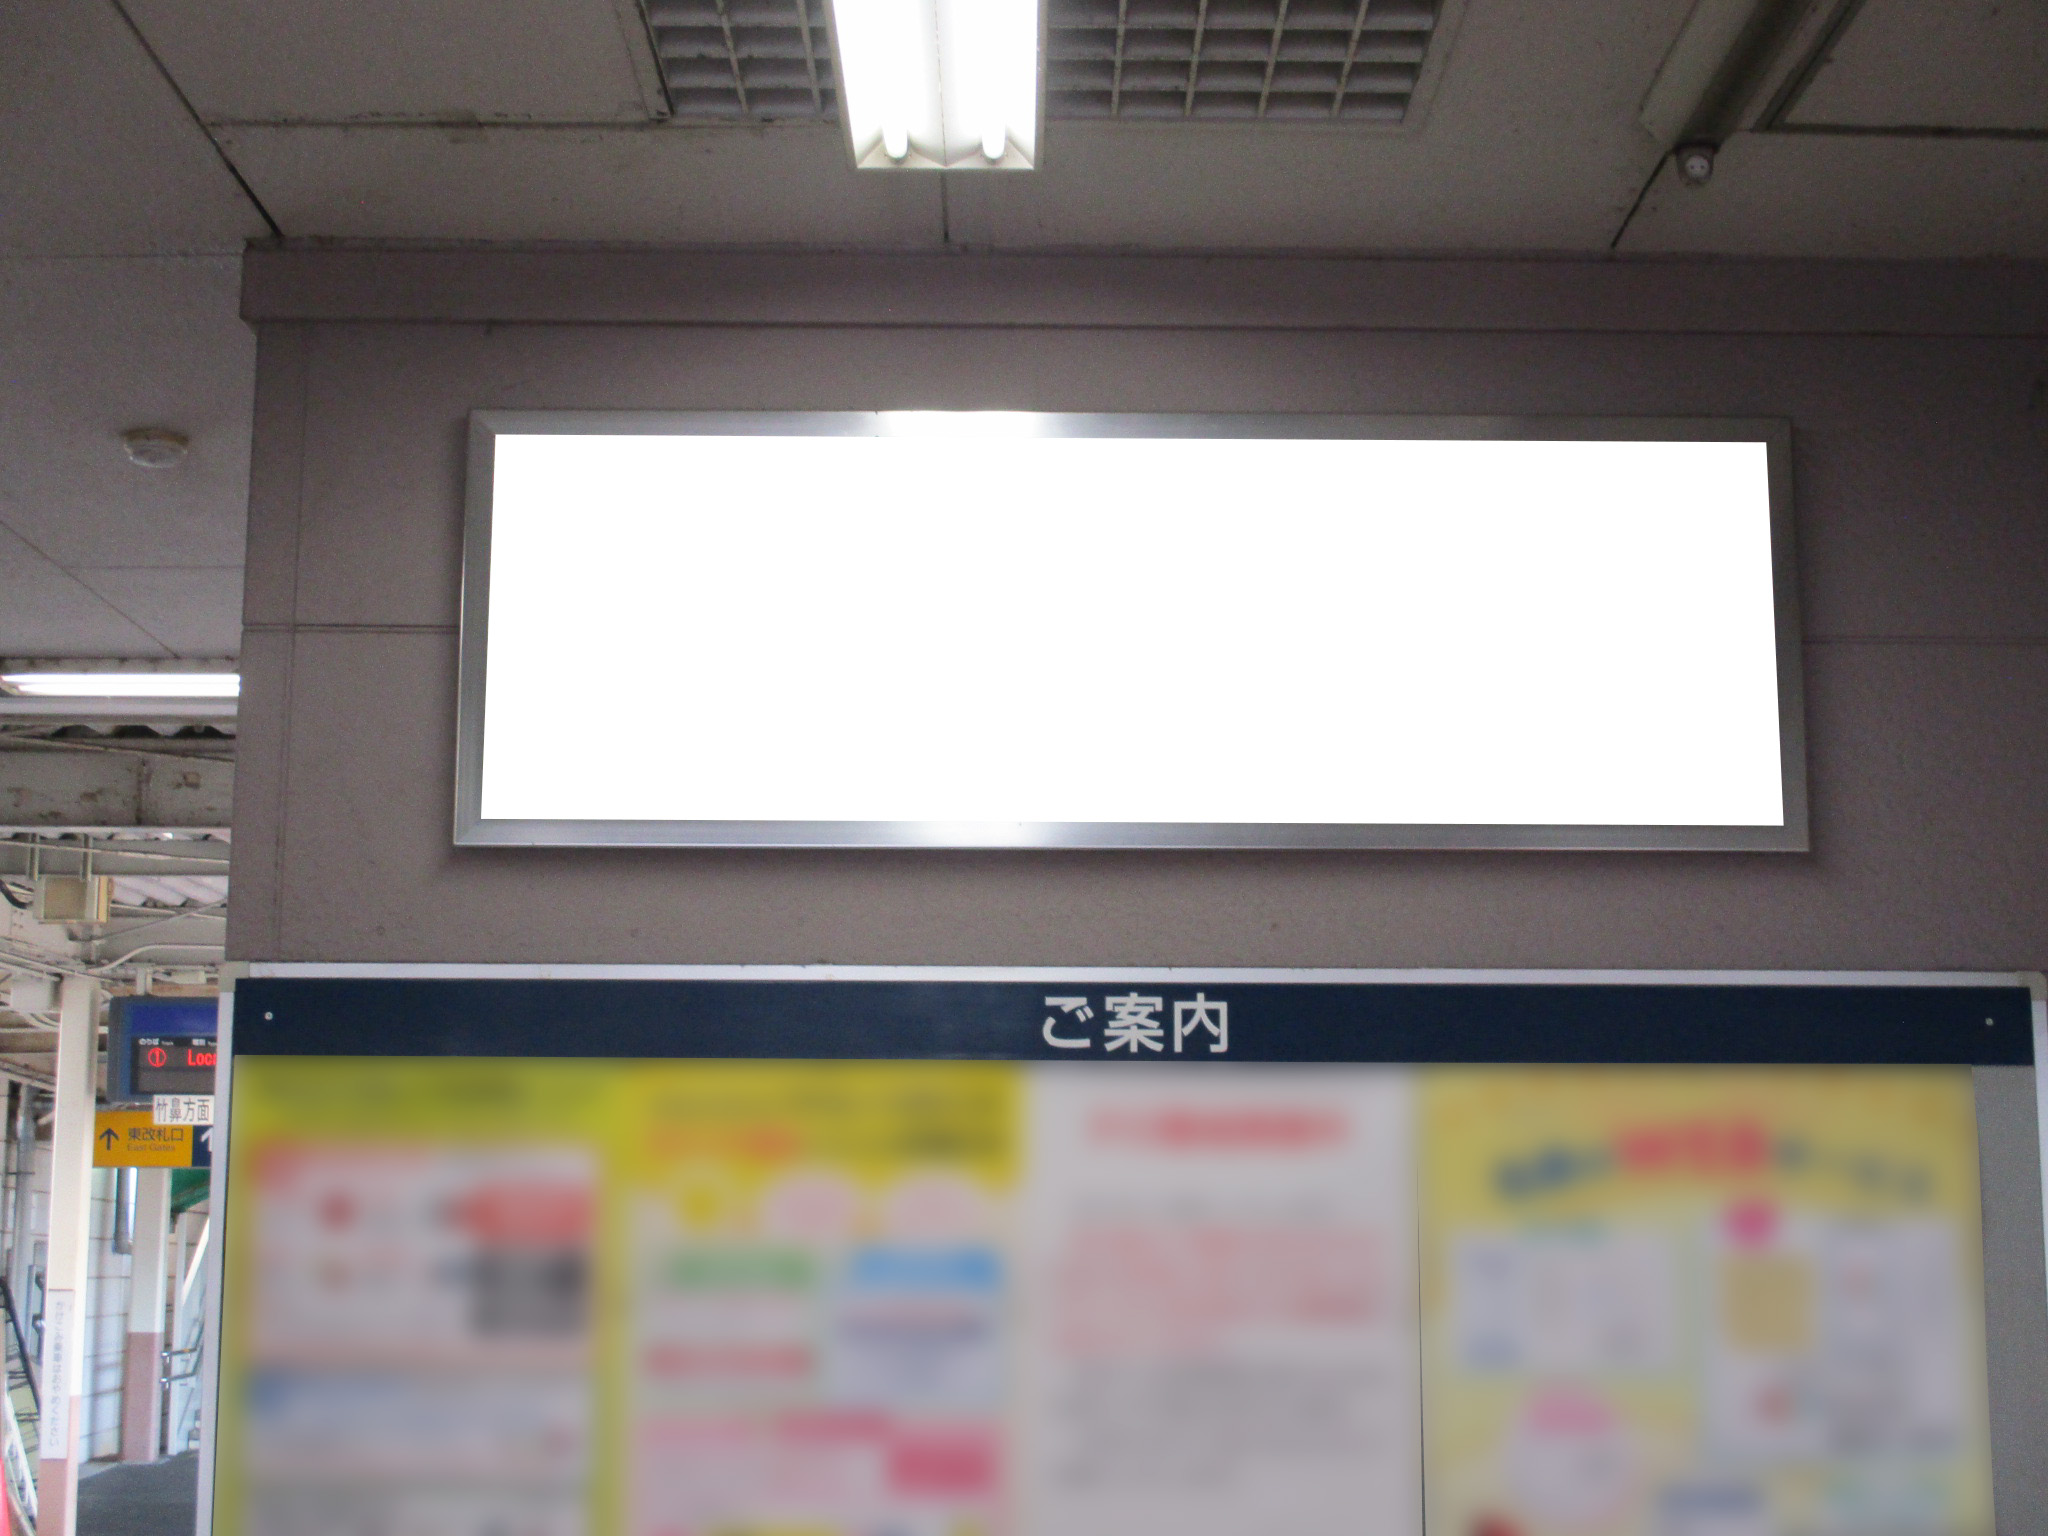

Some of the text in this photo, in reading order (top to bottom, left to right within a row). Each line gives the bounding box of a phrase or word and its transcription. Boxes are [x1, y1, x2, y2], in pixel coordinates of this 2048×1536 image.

[1042, 992, 1229, 1054] ご案内
[156, 1097, 209, 1122] 竹鼻方面
[128, 1127, 184, 1142] 東改札口
